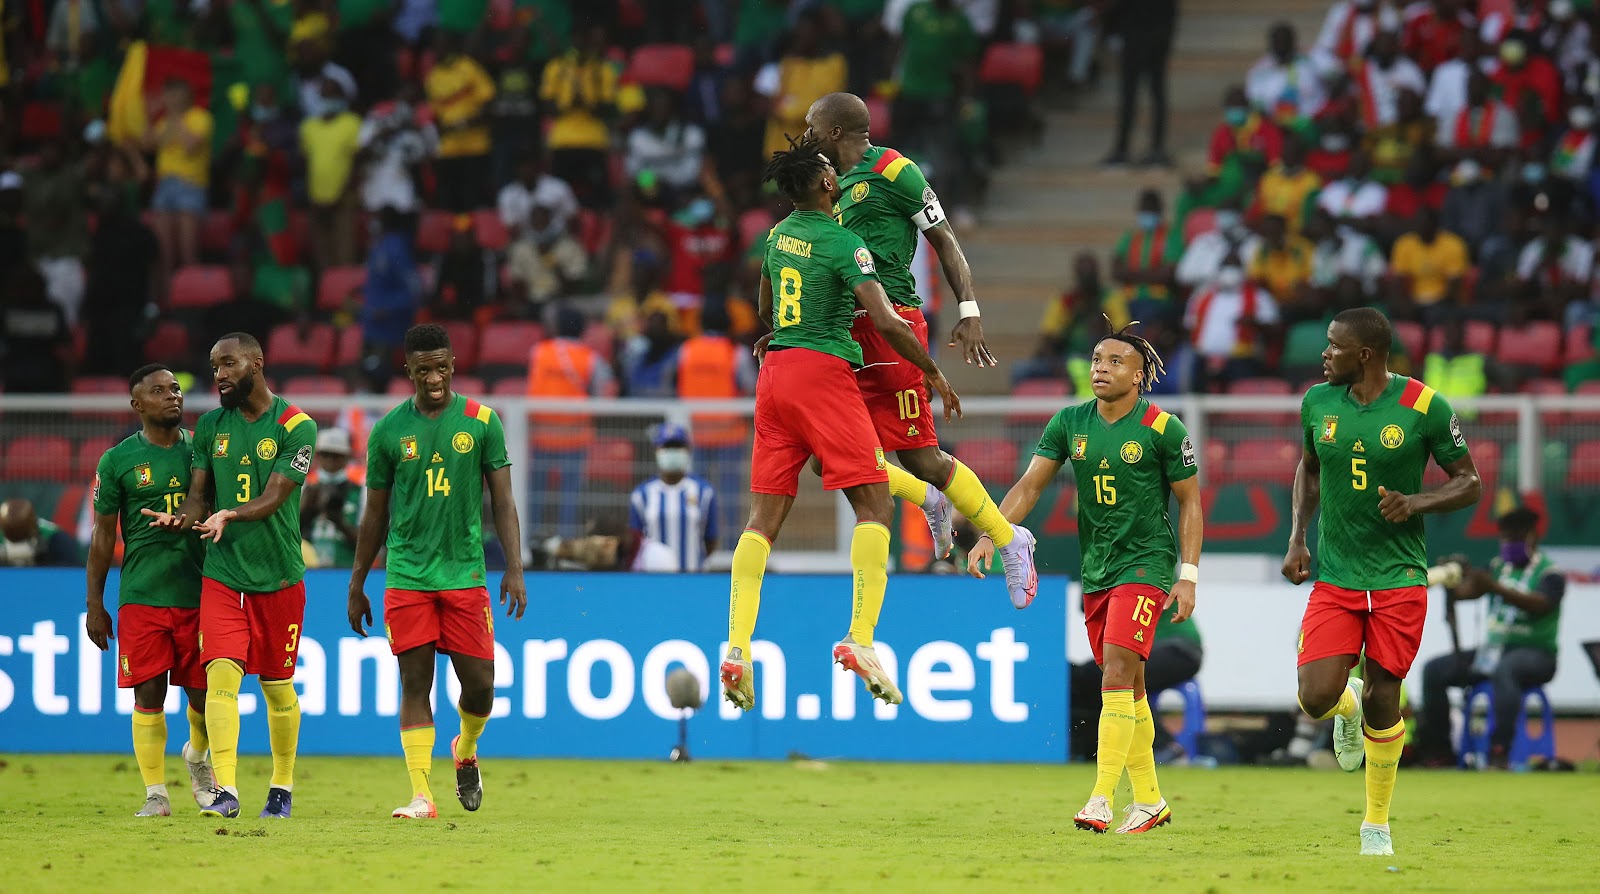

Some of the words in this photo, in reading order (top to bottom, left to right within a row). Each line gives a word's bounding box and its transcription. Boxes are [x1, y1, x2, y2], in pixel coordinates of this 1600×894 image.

[923, 204, 938, 224] C
[775, 234, 813, 258] ANGUISSA
[778, 266, 802, 327] 8
[895, 389, 920, 420] 10
[236, 473, 251, 503] 3
[425, 467, 450, 497] 14
[1351, 457, 1367, 490] 5
[1092, 474, 1117, 506] 15
[730, 580, 738, 631] CAMEROUN
[853, 569, 865, 620] CAMEROUN
[1131, 595, 1156, 627] 15
[285, 623, 299, 652] 3
